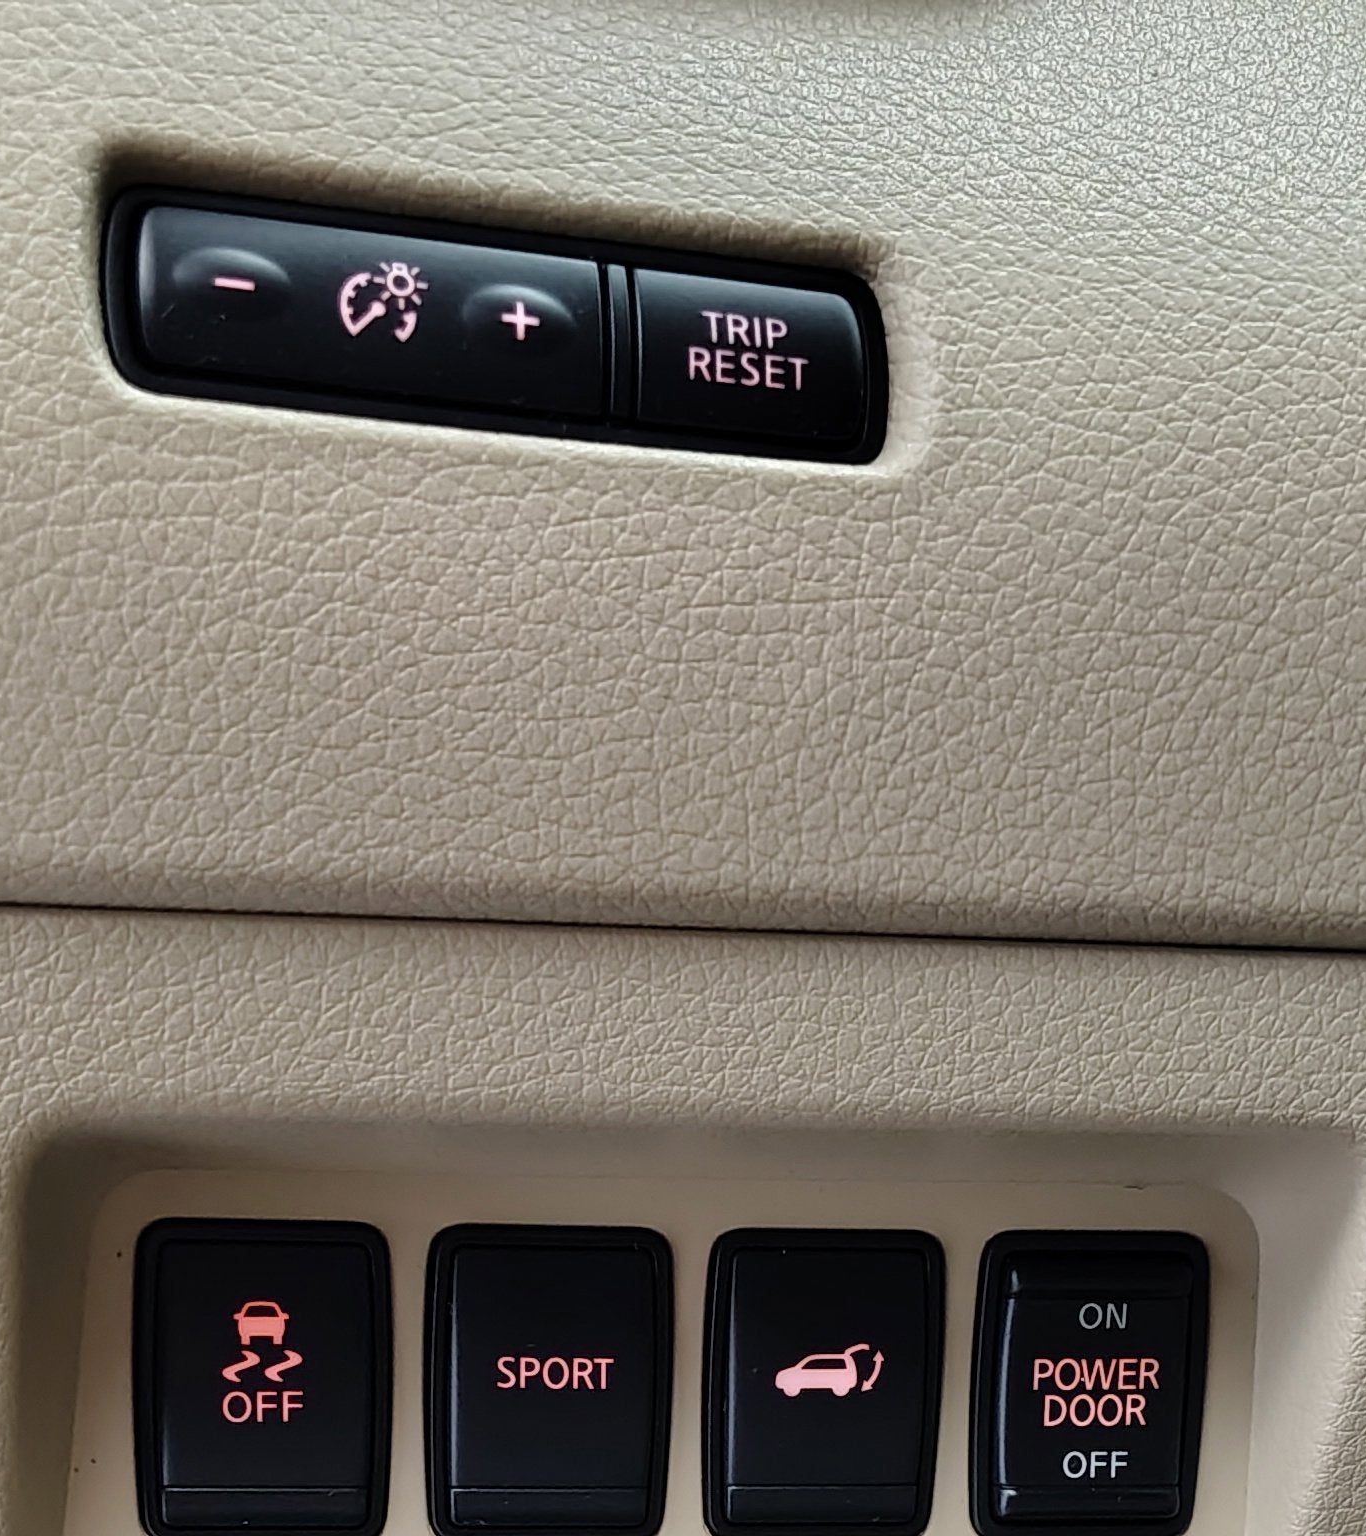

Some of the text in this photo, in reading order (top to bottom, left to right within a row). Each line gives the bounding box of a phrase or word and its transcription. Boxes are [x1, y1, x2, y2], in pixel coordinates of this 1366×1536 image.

[700, 310, 788, 350] TRIP
[686, 347, 808, 392] RESET
[1078, 1302, 1128, 1330] ON
[496, 1355, 614, 1391] SPORT
[1033, 1357, 1160, 1391] POWER
[222, 1390, 304, 1423] OFF
[1043, 1393, 1146, 1427] DOOR
[1062, 1450, 1129, 1479] OFF
